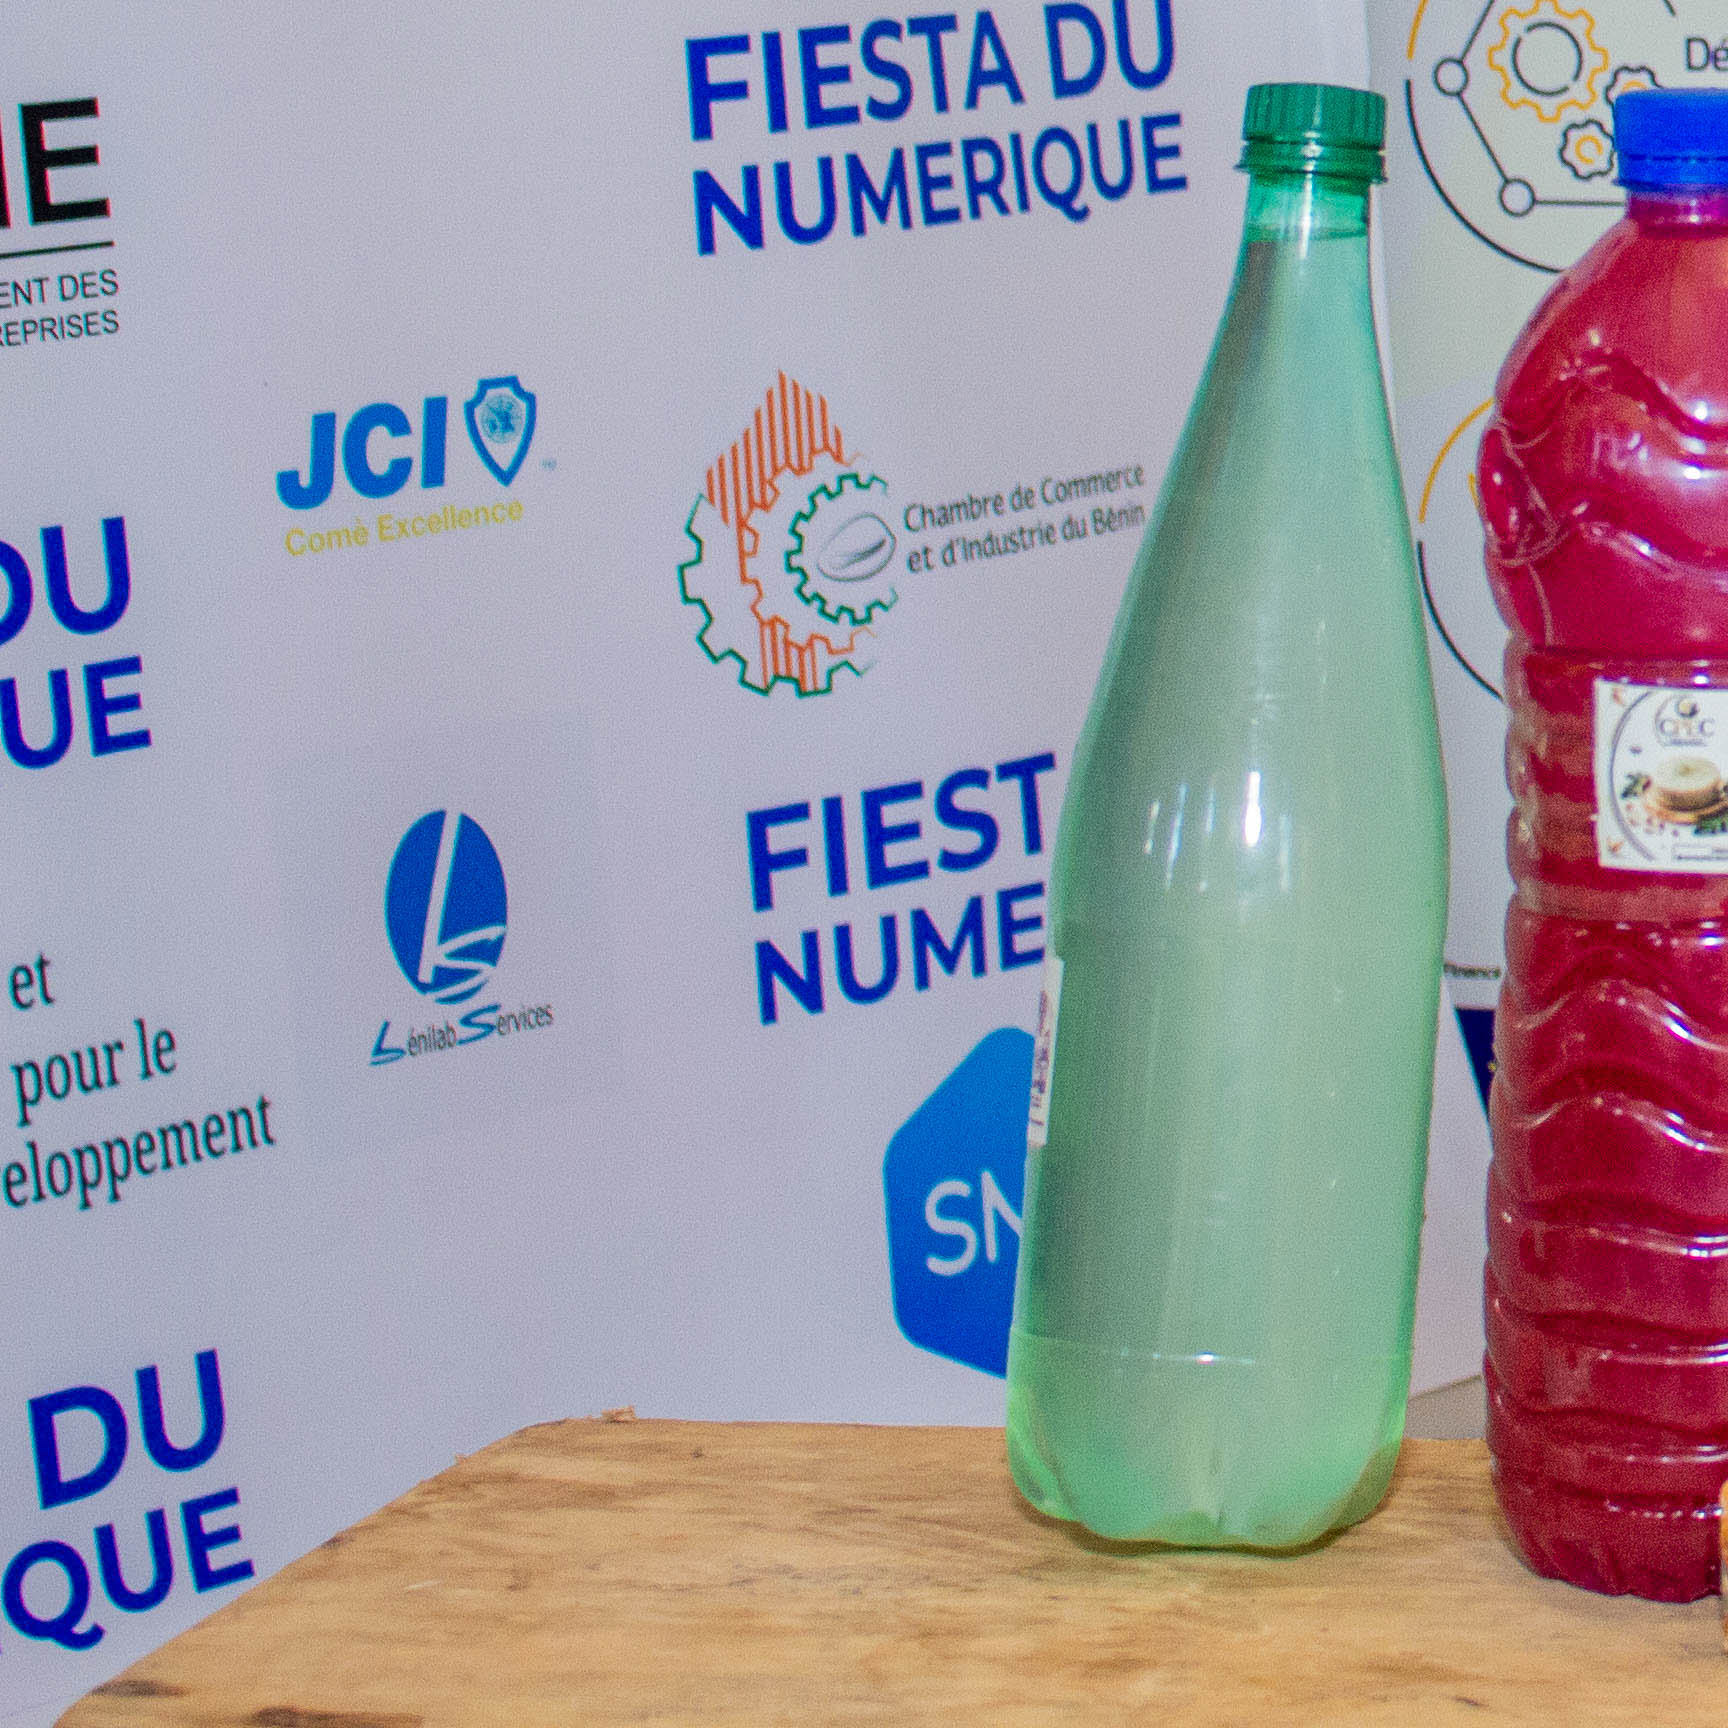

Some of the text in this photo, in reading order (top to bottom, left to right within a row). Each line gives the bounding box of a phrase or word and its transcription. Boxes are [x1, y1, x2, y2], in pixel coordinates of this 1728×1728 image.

[683, 7, 1026, 144] FIESTA
[691, 111, 1192, 258] NUMERIQUE
[57, 269, 121, 303] DES
[0, 309, 121, 348] EPRISES
[275, 395, 449, 511] JCI
[376, 499, 525, 543] Excellence
[904, 463, 1145, 533] Chambre de Commerce
[906, 500, 1146, 574] et d'Industrie du Bénin
[8, 952, 55, 1012] et
[9, 1016, 178, 1129] pour le
[26, 1346, 226, 1511] DU
